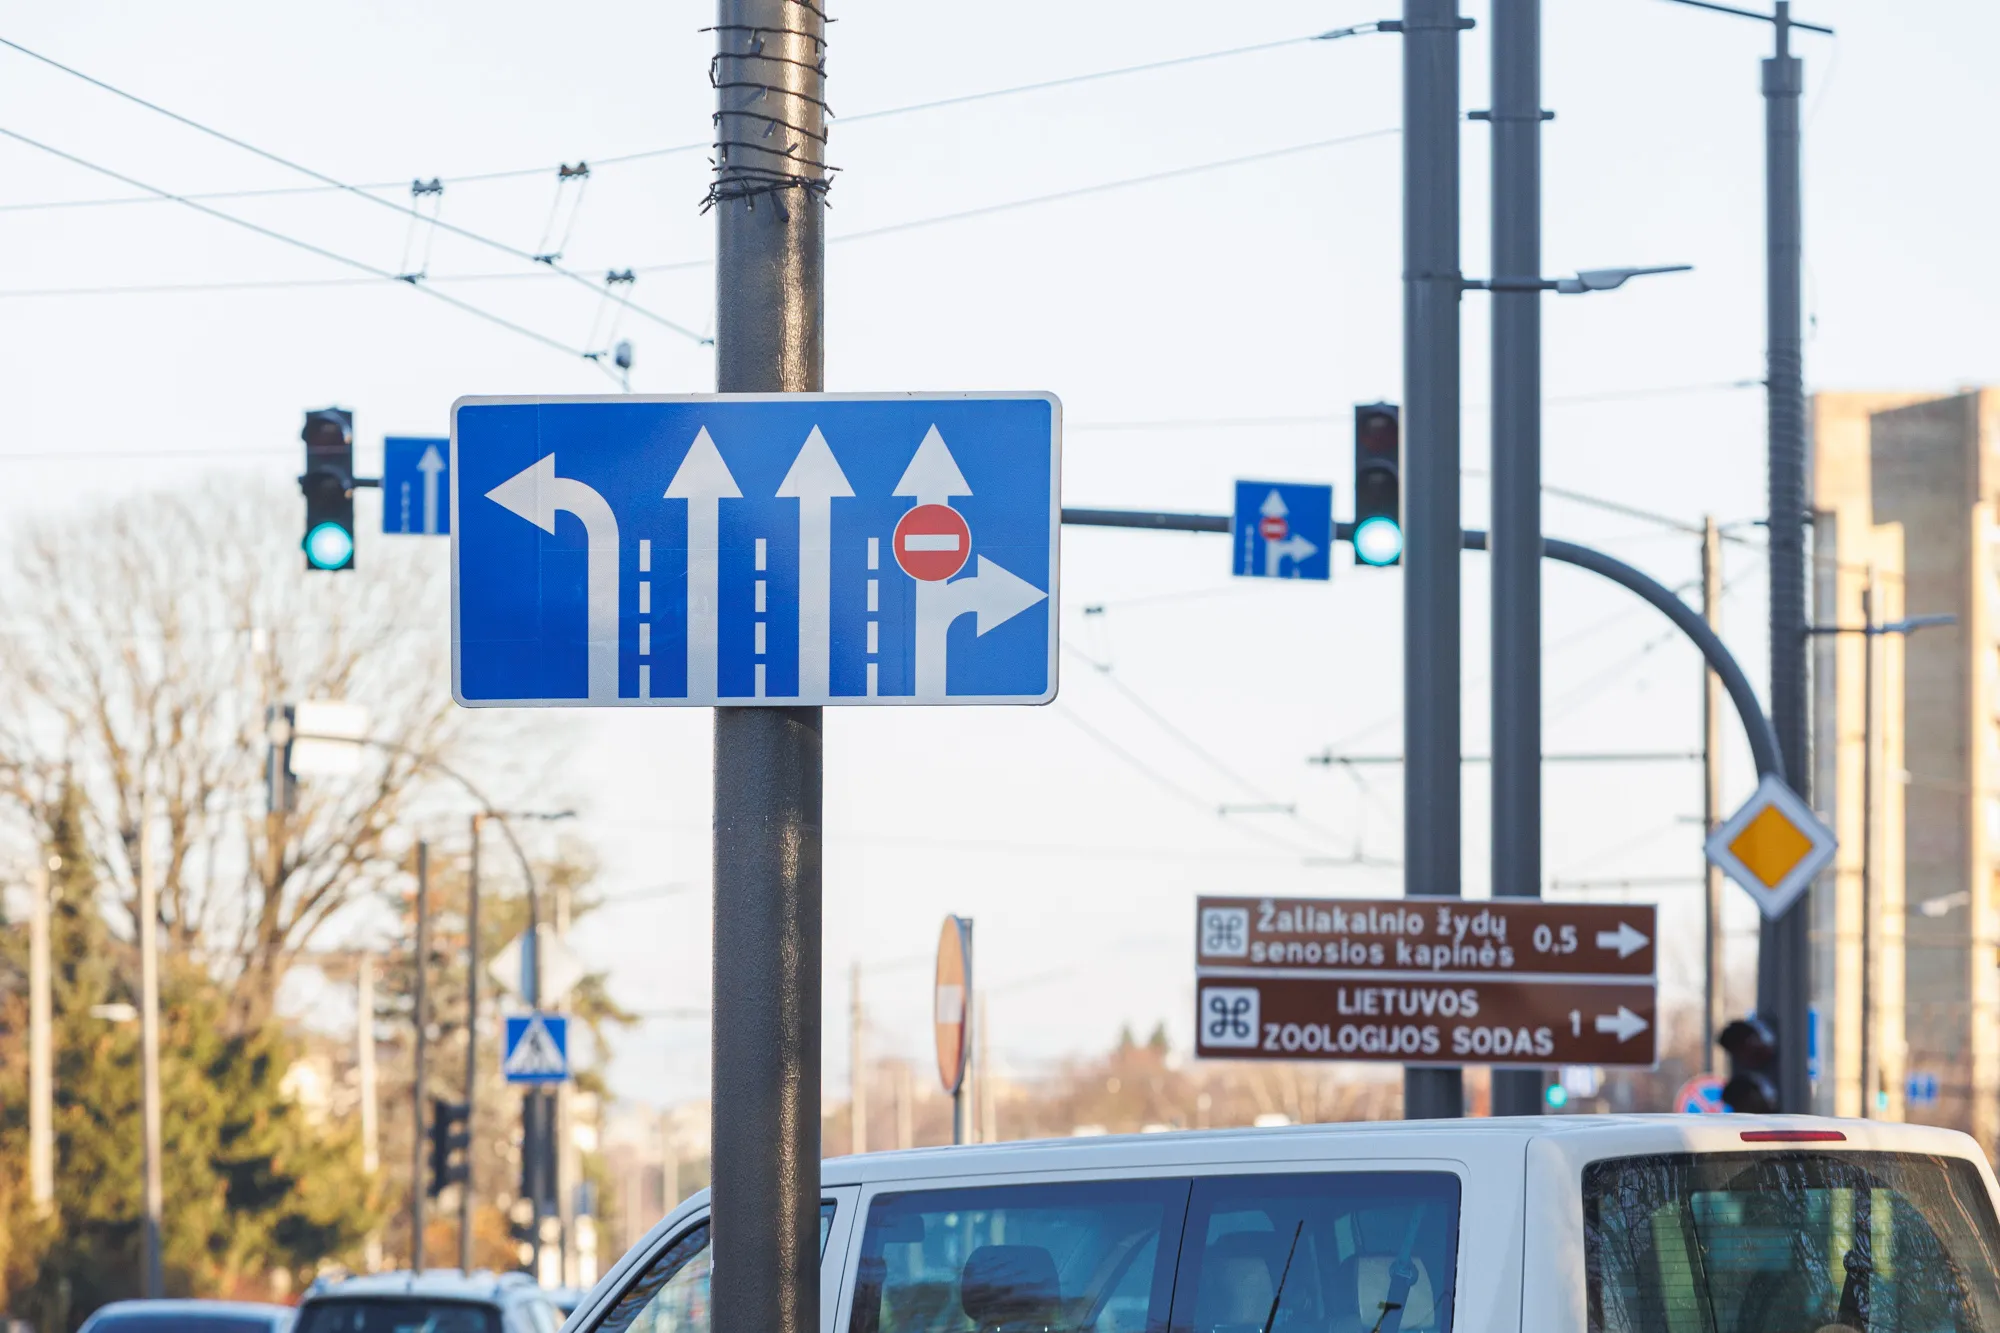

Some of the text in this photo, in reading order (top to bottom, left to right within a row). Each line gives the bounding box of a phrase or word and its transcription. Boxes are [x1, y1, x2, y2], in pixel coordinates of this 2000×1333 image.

[1256, 899, 1507, 943] Žaliakalnio žydų
[1250, 938, 1385, 965] senosios
[1533, 925, 1578, 955] 0,5
[1337, 988, 1480, 1017] LIETUVOS
[1568, 1009, 1581, 1037] 1
[1263, 1023, 1554, 1056] ZOOLOGIJOS SODAS
